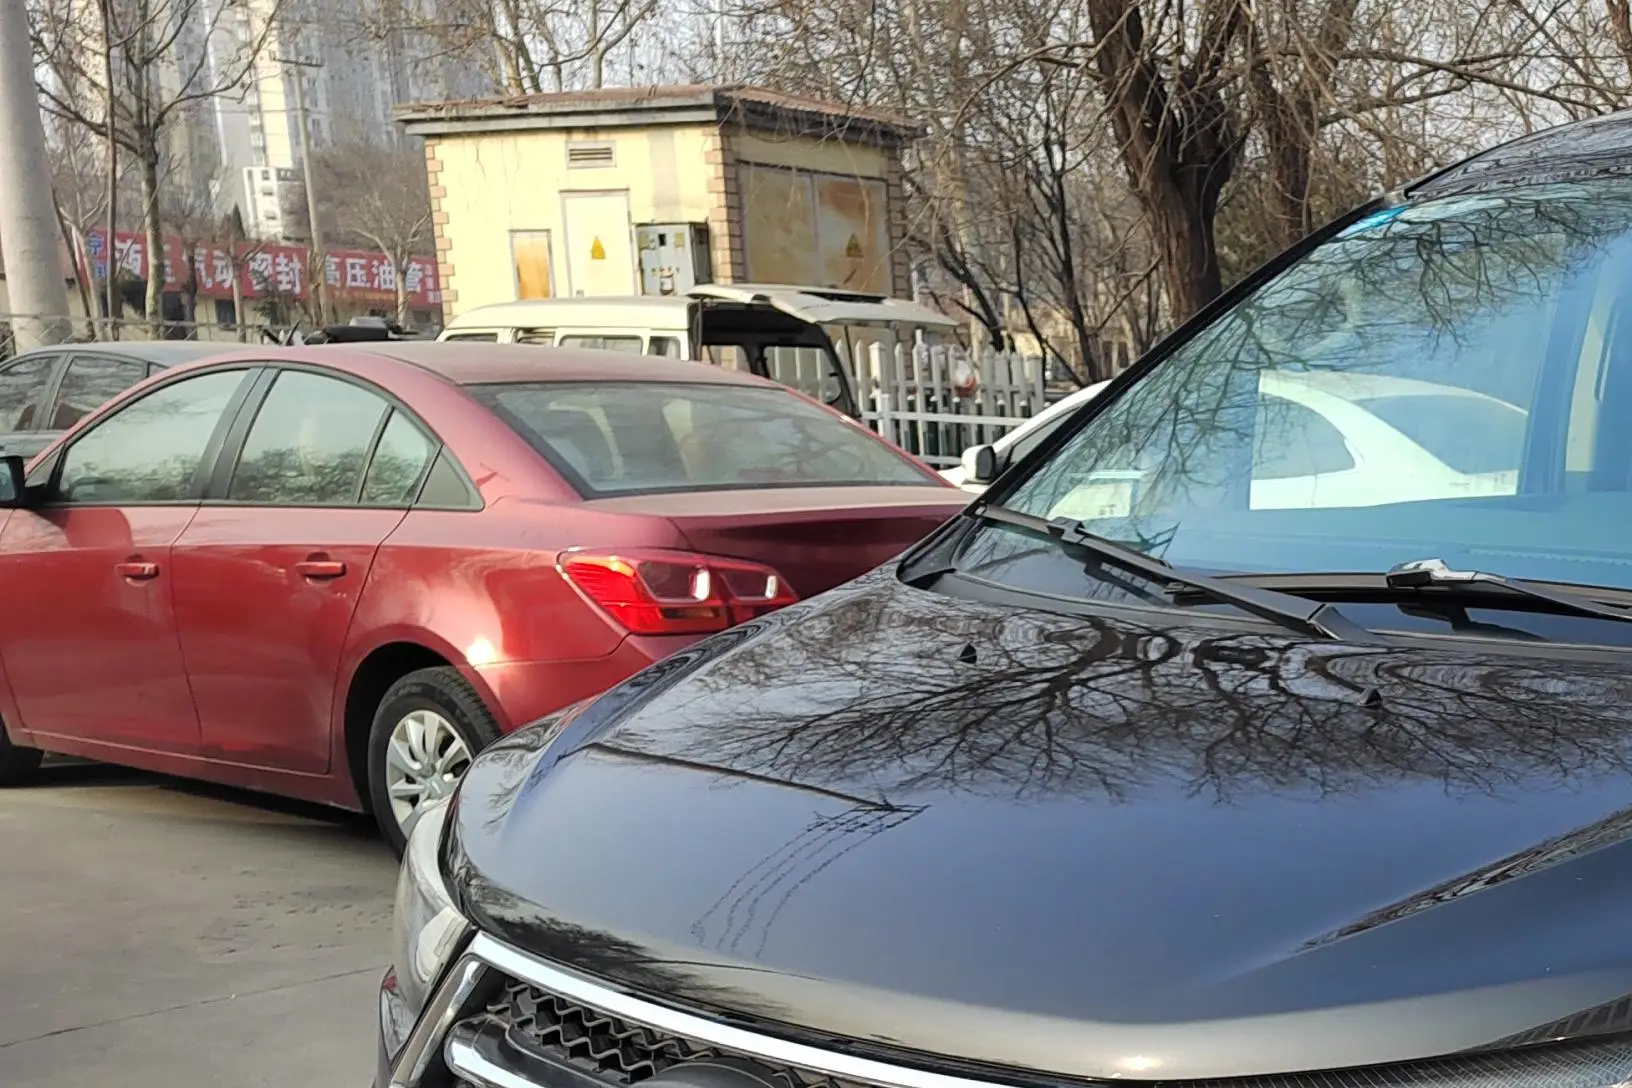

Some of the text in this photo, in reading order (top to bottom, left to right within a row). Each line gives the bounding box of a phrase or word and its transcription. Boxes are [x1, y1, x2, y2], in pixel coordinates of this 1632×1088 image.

[249, 252, 301, 293] 密封
[324, 255, 422, 292] 高压油管
